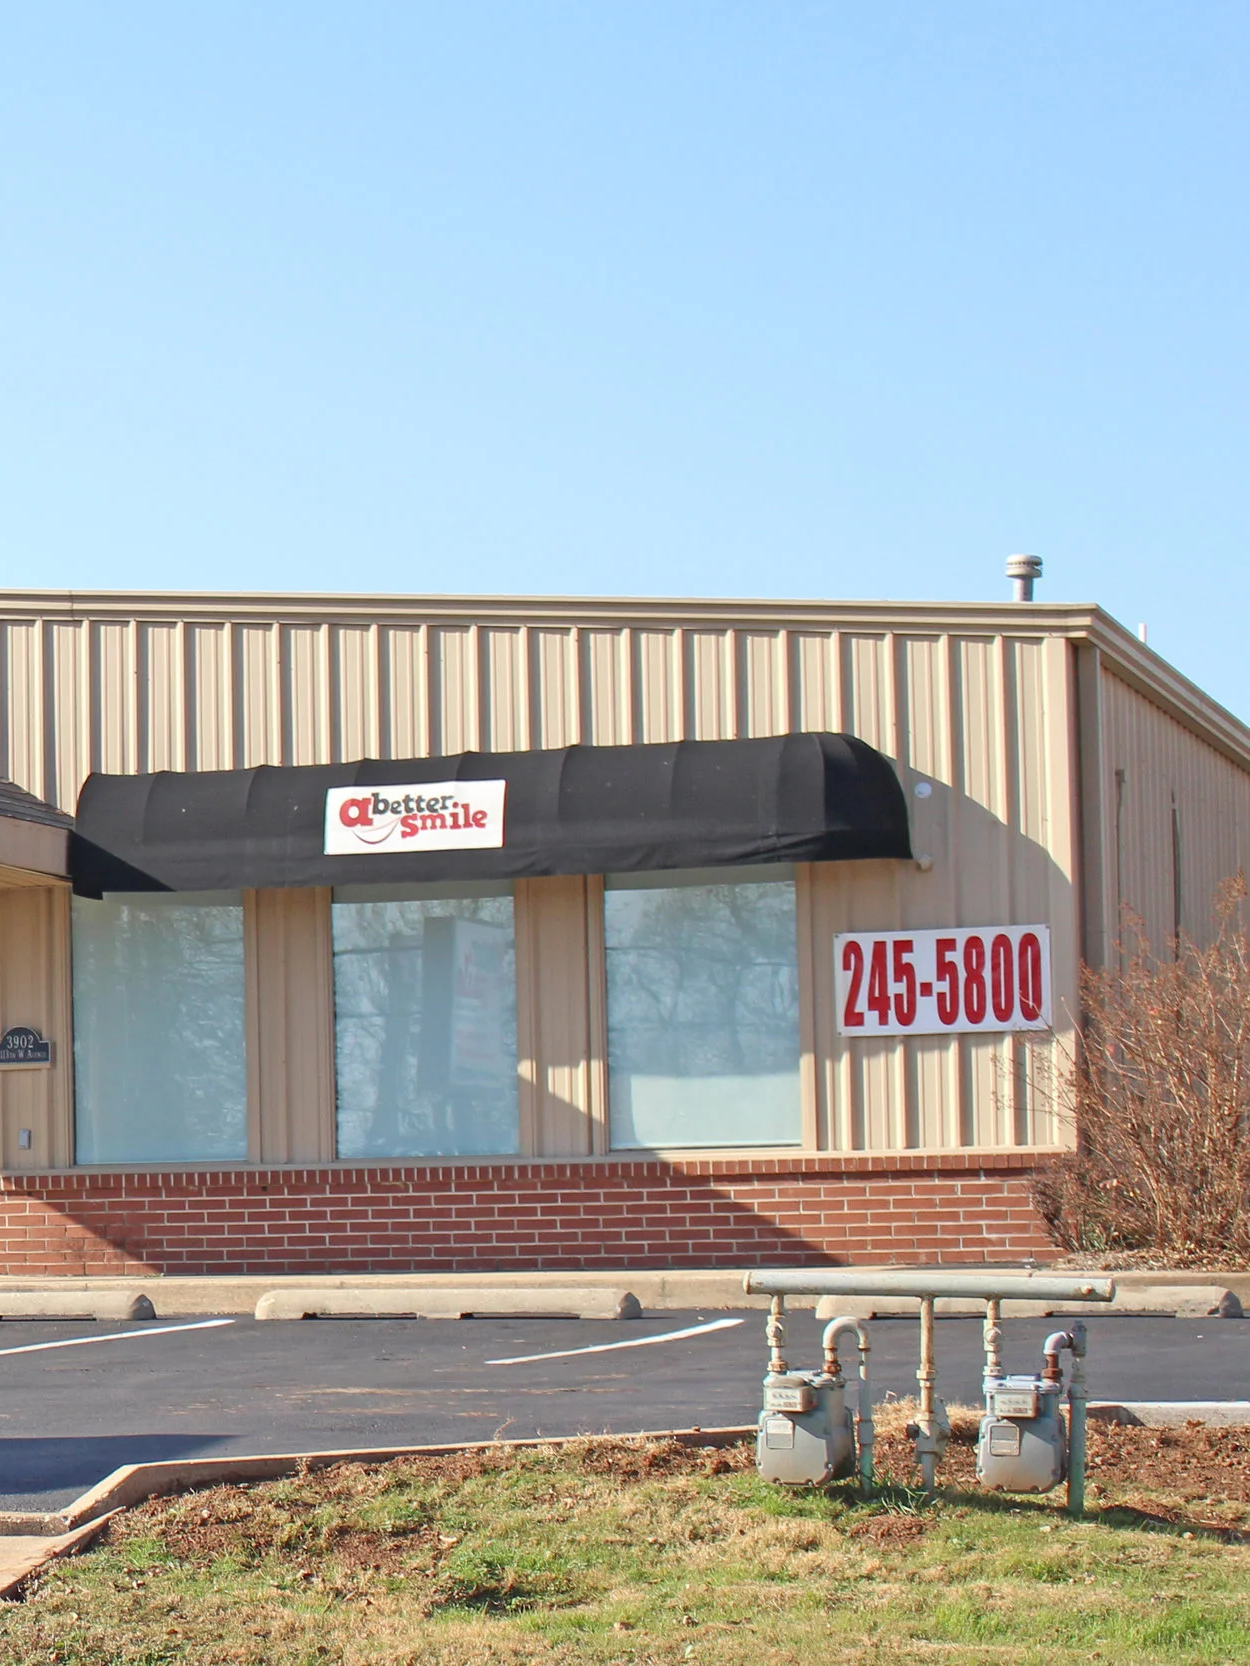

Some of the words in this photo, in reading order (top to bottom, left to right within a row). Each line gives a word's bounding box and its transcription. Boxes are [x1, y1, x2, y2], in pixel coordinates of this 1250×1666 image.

[339, 797, 373, 827] a
[371, 792, 454, 815] better
[400, 802, 488, 839] smile
[842, 932, 1043, 1027] 245-5800
[6, 1034, 34, 1049] 3902
